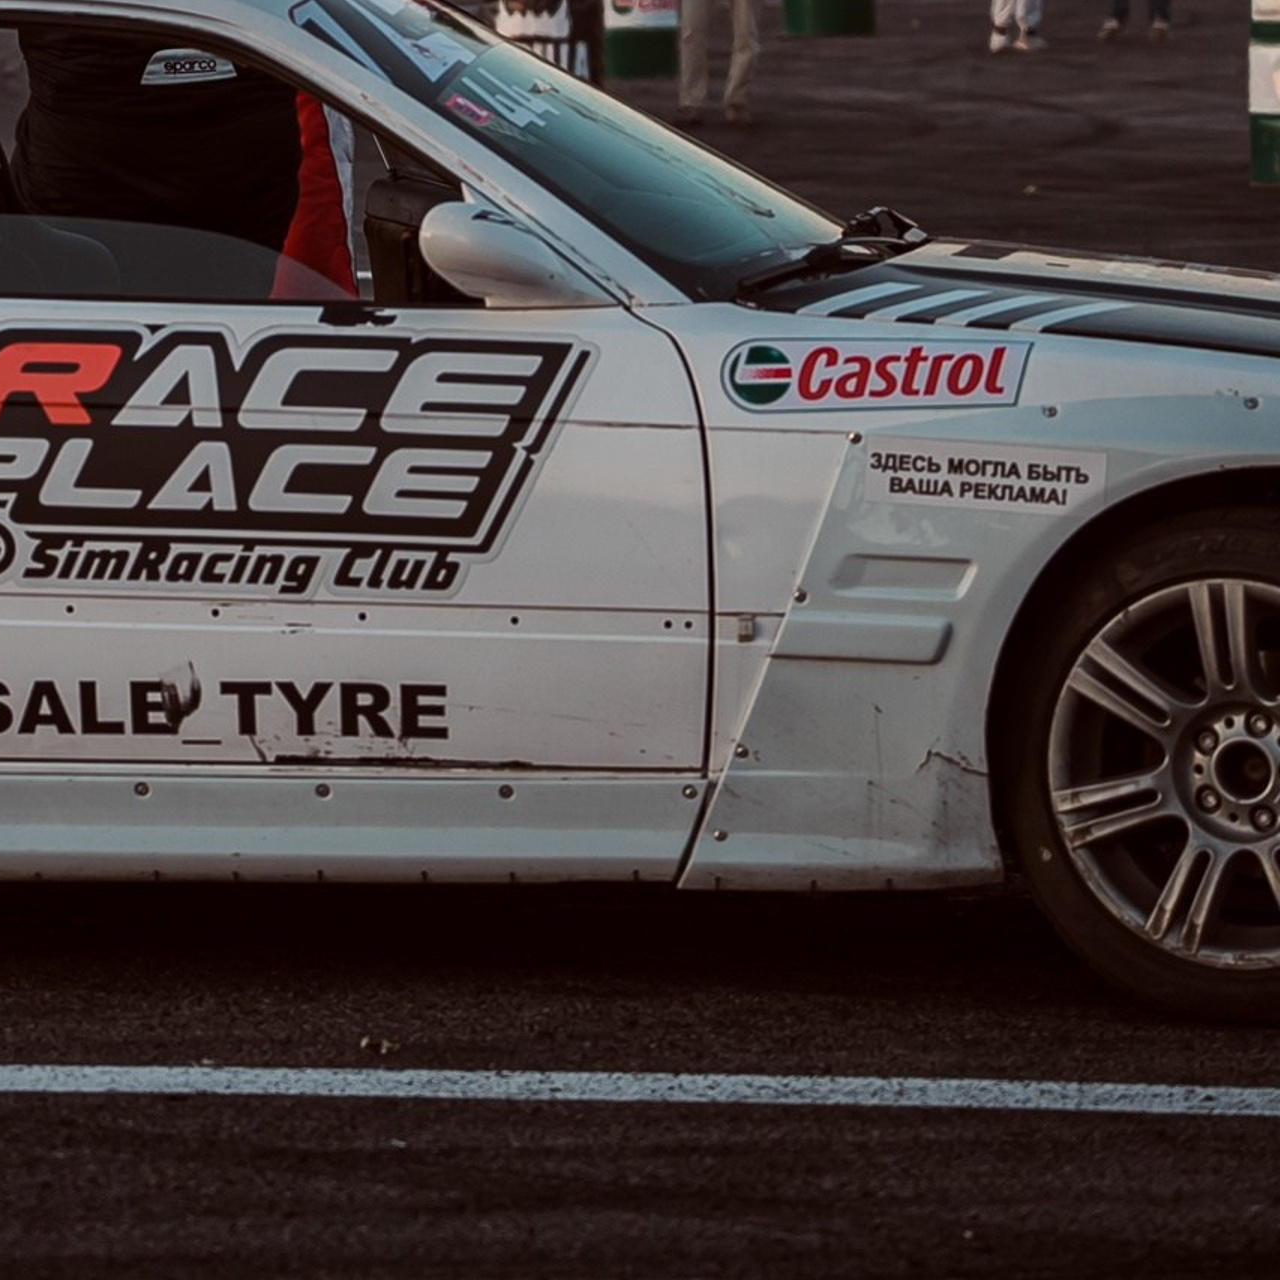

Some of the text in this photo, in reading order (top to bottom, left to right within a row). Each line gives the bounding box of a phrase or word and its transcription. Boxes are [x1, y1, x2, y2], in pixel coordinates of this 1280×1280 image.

[797, 345, 1008, 402] Castrol
[869, 452, 1090, 485] ЗДЕСЬ МОГЛА БЫТЬ
[889, 476, 1068, 506] ВАША РЕКЛАМА!
[22, 534, 461, 594] SimRacing Club
